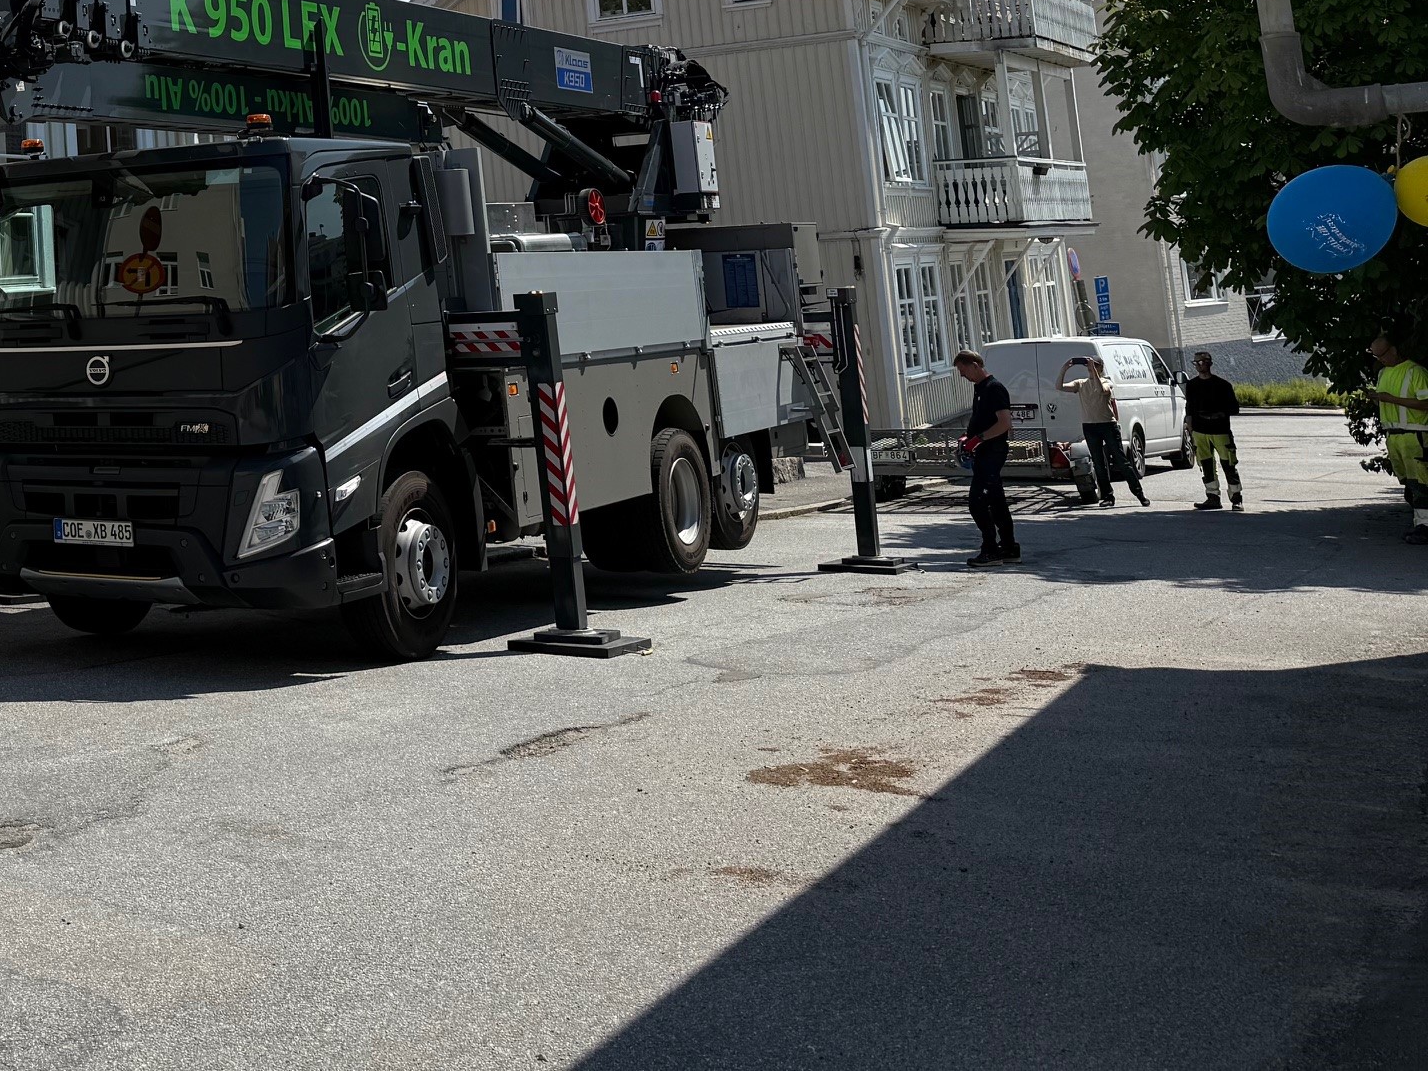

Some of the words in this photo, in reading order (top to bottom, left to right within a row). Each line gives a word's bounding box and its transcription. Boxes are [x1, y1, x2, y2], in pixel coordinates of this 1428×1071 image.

[565, 54, 589, 69] Klaas
[564, 71, 585, 88] K950
[144, 74, 183, 111] Alu
[188, 79, 250, 116] 100%
[267, 88, 314, 123] Akku
[1098, 278, 1106, 292] P
[890, 451, 907, 460] 864
[62, 522, 84, 538] COE
[92, 523, 108, 539] XB
[110, 524, 132, 540] 485
